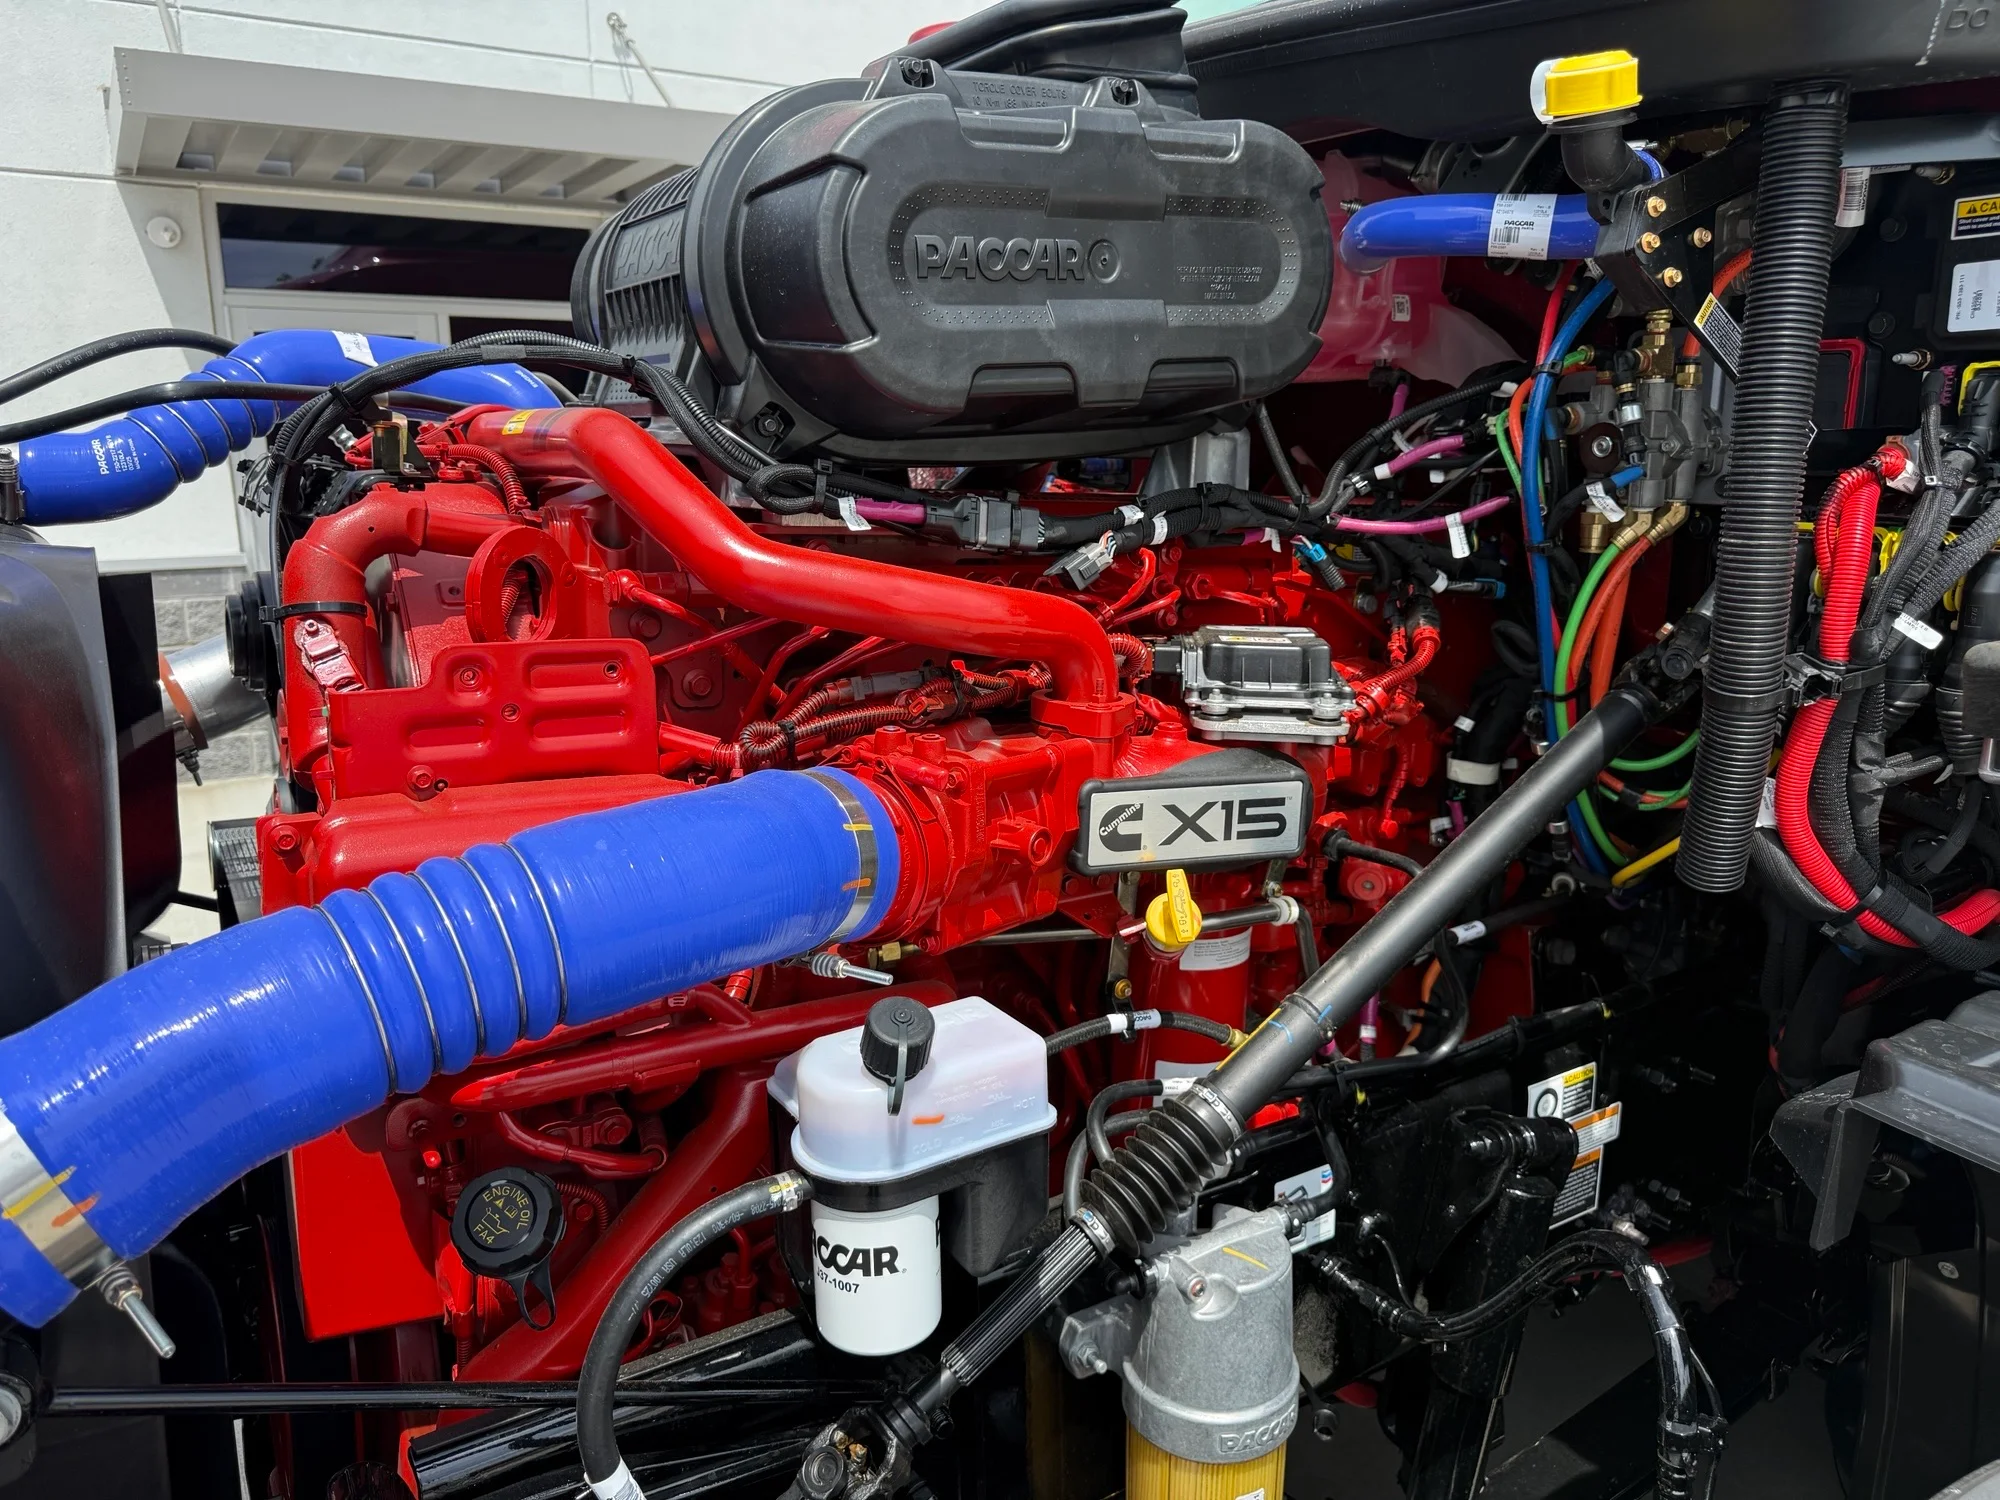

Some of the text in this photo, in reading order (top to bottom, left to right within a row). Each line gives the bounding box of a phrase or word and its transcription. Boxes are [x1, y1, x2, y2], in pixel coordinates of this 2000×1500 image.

[972, 82, 1068, 99] TORQUE COVER BOLTS
[1980, 201, 2000, 213] CA
[1504, 219, 1535, 227] PACCAR
[615, 218, 681, 281] PACCA
[915, 234, 1085, 282] PACCAR
[1697, 297, 1714, 325] CAUTION
[91, 438, 110, 476] PACCAR
[1099, 797, 1288, 847] Cummins X15
[901, 834, 911, 868] MADE
[1013, 1096, 1036, 1112] HOT
[482, 1186, 531, 1230] ENGINE OIL
[473, 1223, 495, 1245] FA4
[677, 1232, 707, 1259] 12310LA
[661, 1257, 678, 1277] USA
[811, 1230, 900, 1278] CCAR
[640, 1272, 665, 1299] 100725
